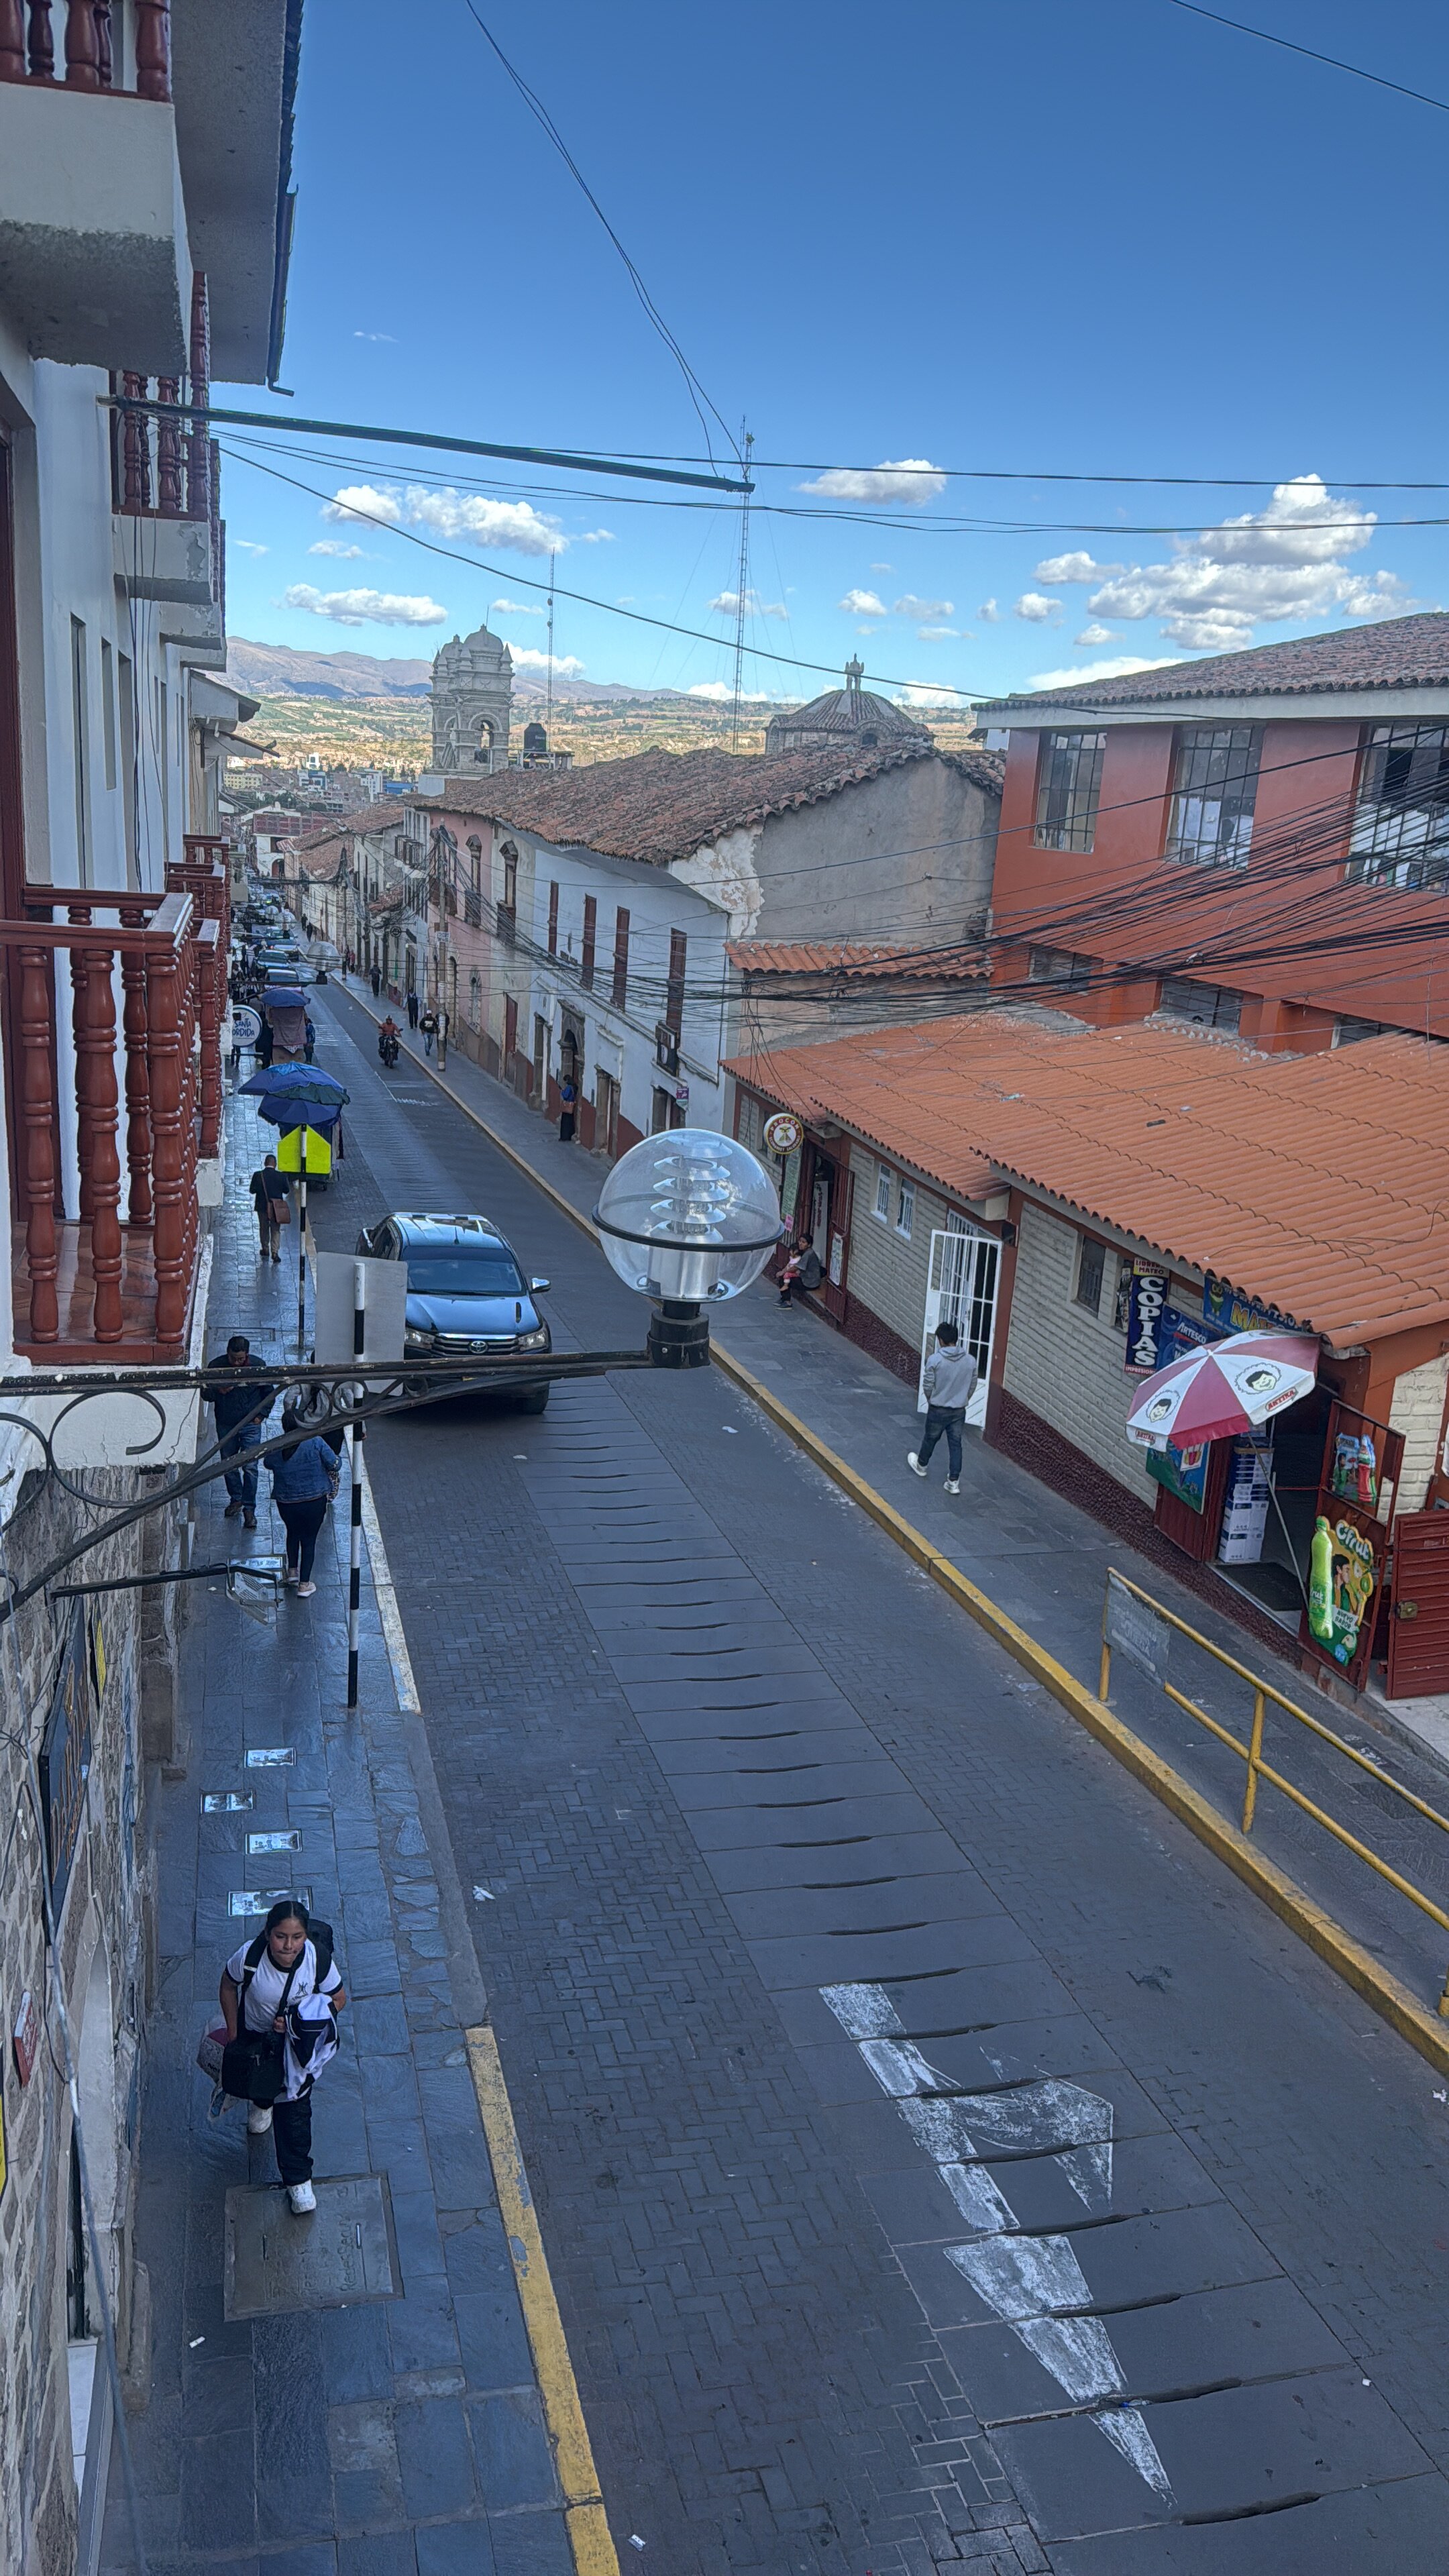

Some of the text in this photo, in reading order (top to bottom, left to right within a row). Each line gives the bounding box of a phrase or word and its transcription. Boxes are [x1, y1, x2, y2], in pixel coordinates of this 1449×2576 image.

[234, 1018, 252, 1028] SANTA
[232, 1028, 255, 1037] ORDIDA
[1132, 1277, 1165, 1366] COPIAS
[1177, 1322, 1207, 1344] ARTESCO
[1125, 1366, 1155, 1375] IMPRESION
[1336, 1523, 1370, 1560] Cifrut
